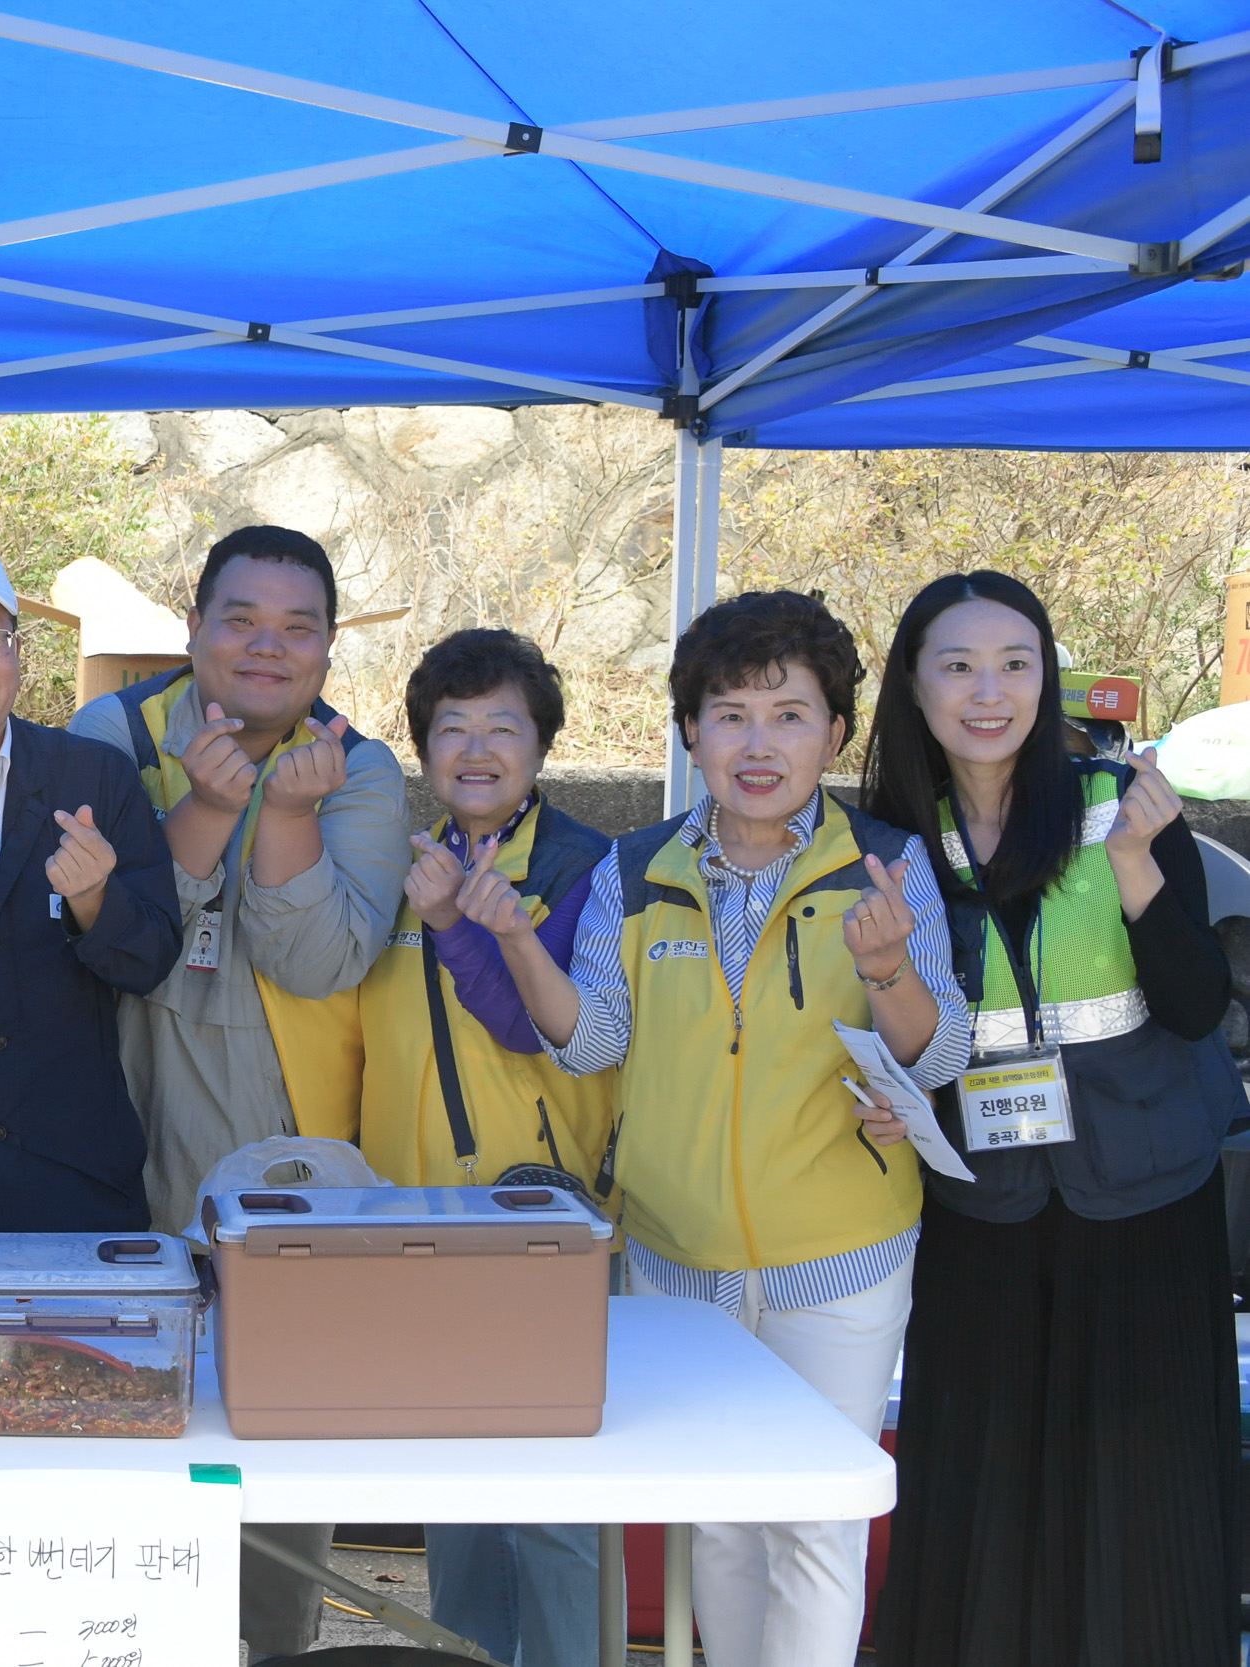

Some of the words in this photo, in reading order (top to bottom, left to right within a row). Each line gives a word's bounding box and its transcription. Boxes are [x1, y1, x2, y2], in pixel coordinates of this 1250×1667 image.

[1090, 689, 1119, 709] 두릅
[980, 1094, 1047, 1117] 진행요원
[28, 1537, 116, 1580] 뻔데기
[135, 1537, 200, 1588] 판매
[77, 1613, 138, 1641] 3000원
